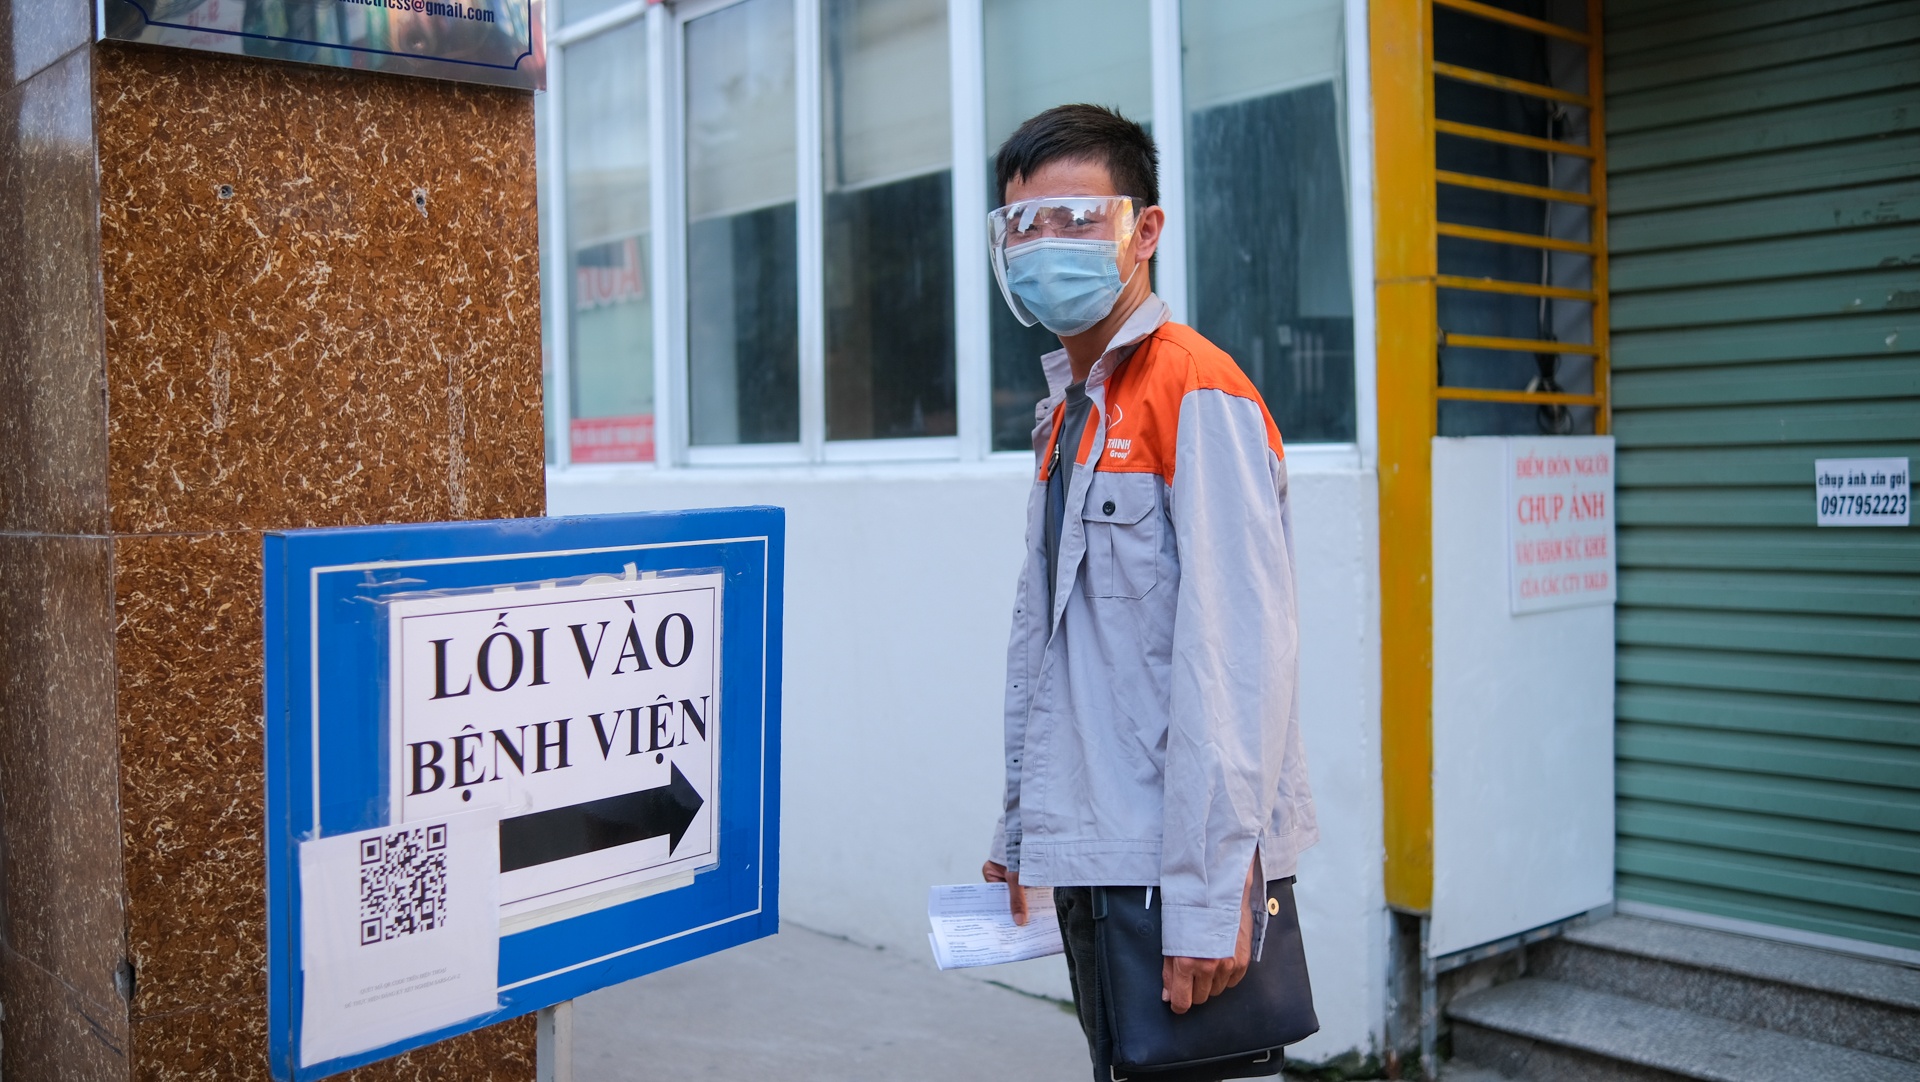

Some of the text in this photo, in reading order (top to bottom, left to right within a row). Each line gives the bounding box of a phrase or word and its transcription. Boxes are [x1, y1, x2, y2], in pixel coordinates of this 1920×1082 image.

[1110, 450, 1127, 460] Group
[1818, 470, 1844, 491] chụp
[1847, 468, 1867, 486] ảnh
[1870, 470, 1886, 486] xin
[1518, 482, 1604, 528] CHỤP ẢNH
[1821, 494, 1907, 516] 0977952223
[428, 599, 694, 700] LỐI VÀO
[406, 694, 711, 802] BỆNH VIỆN
